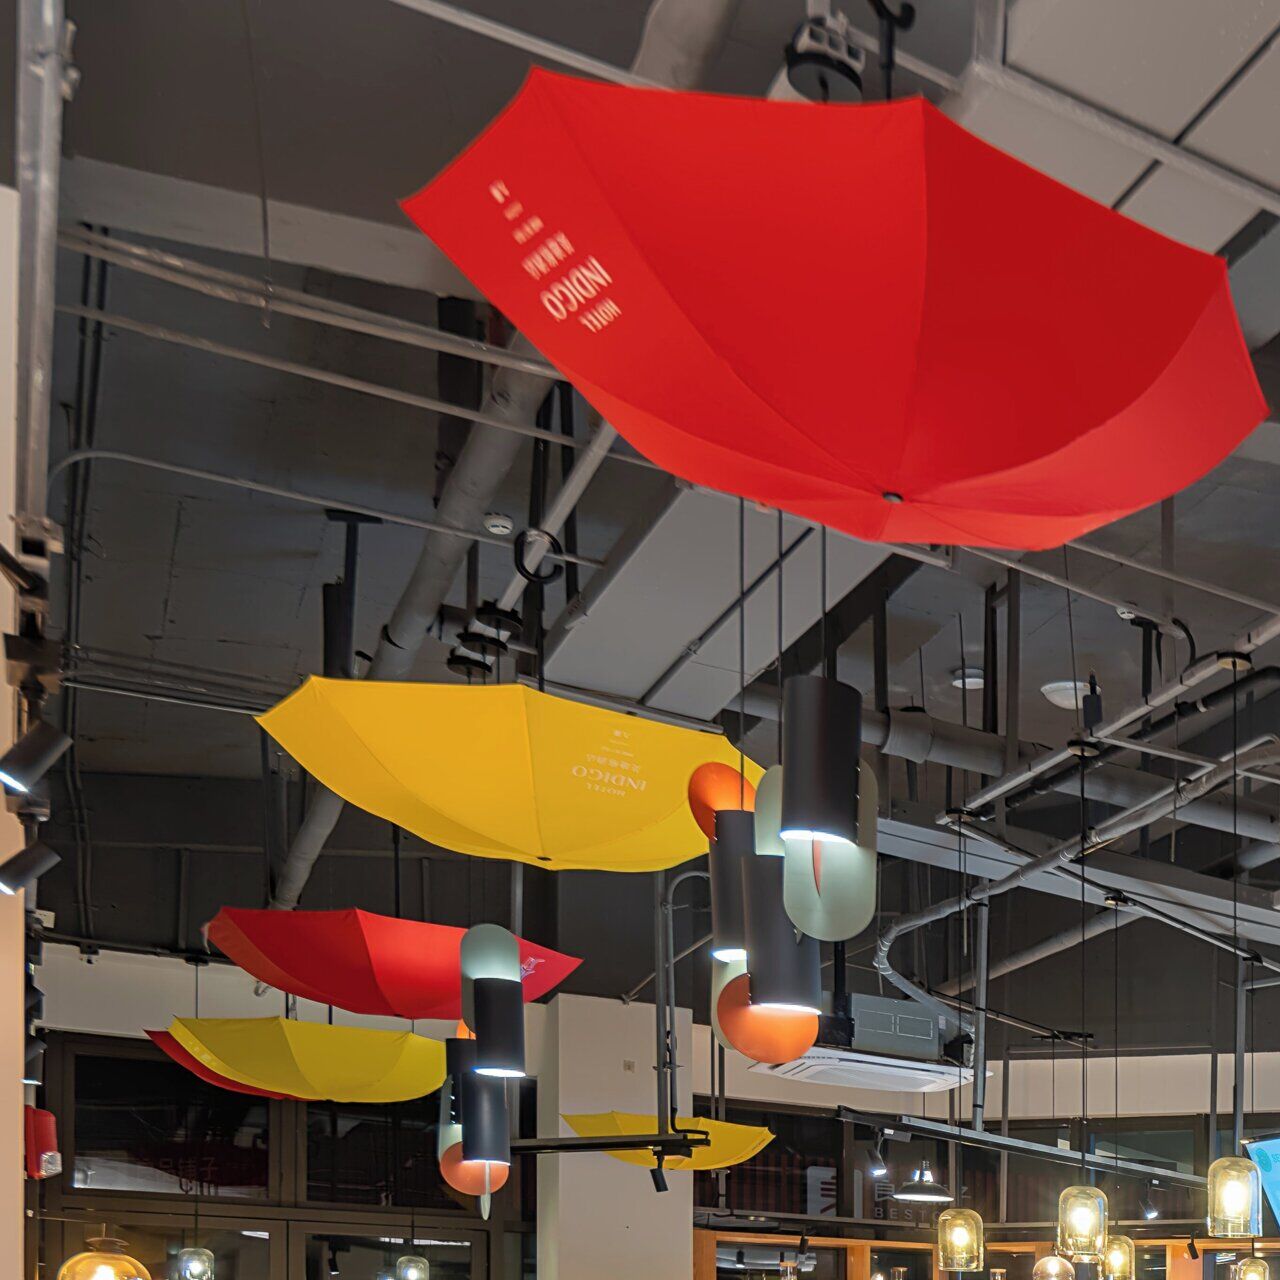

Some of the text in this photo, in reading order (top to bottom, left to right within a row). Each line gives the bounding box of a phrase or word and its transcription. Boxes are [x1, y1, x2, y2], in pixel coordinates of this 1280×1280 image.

[539, 255, 613, 322] INDIGO
[576, 296, 622, 334] HOTEL
[572, 766, 648, 792] INDIGO
